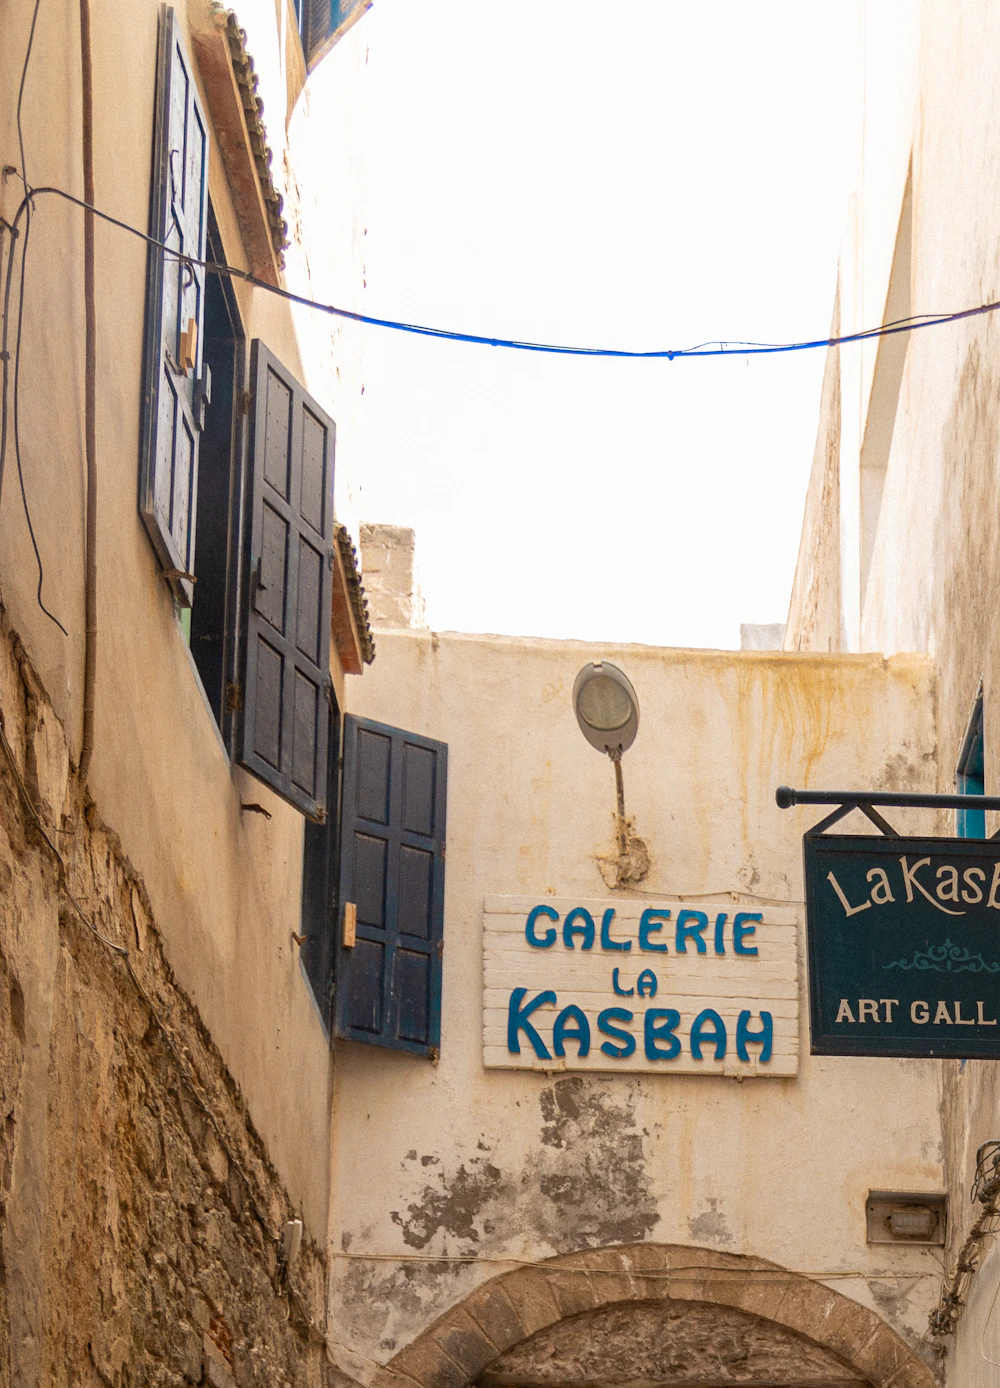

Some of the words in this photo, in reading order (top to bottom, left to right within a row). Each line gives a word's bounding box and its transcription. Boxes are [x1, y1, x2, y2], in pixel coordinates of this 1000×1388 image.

[826, 867, 896, 917] La
[525, 904, 763, 956] GALERIE
[612, 967, 658, 997] LA
[507, 987, 774, 1063] KASBAH
[835, 998, 899, 1023] ART
